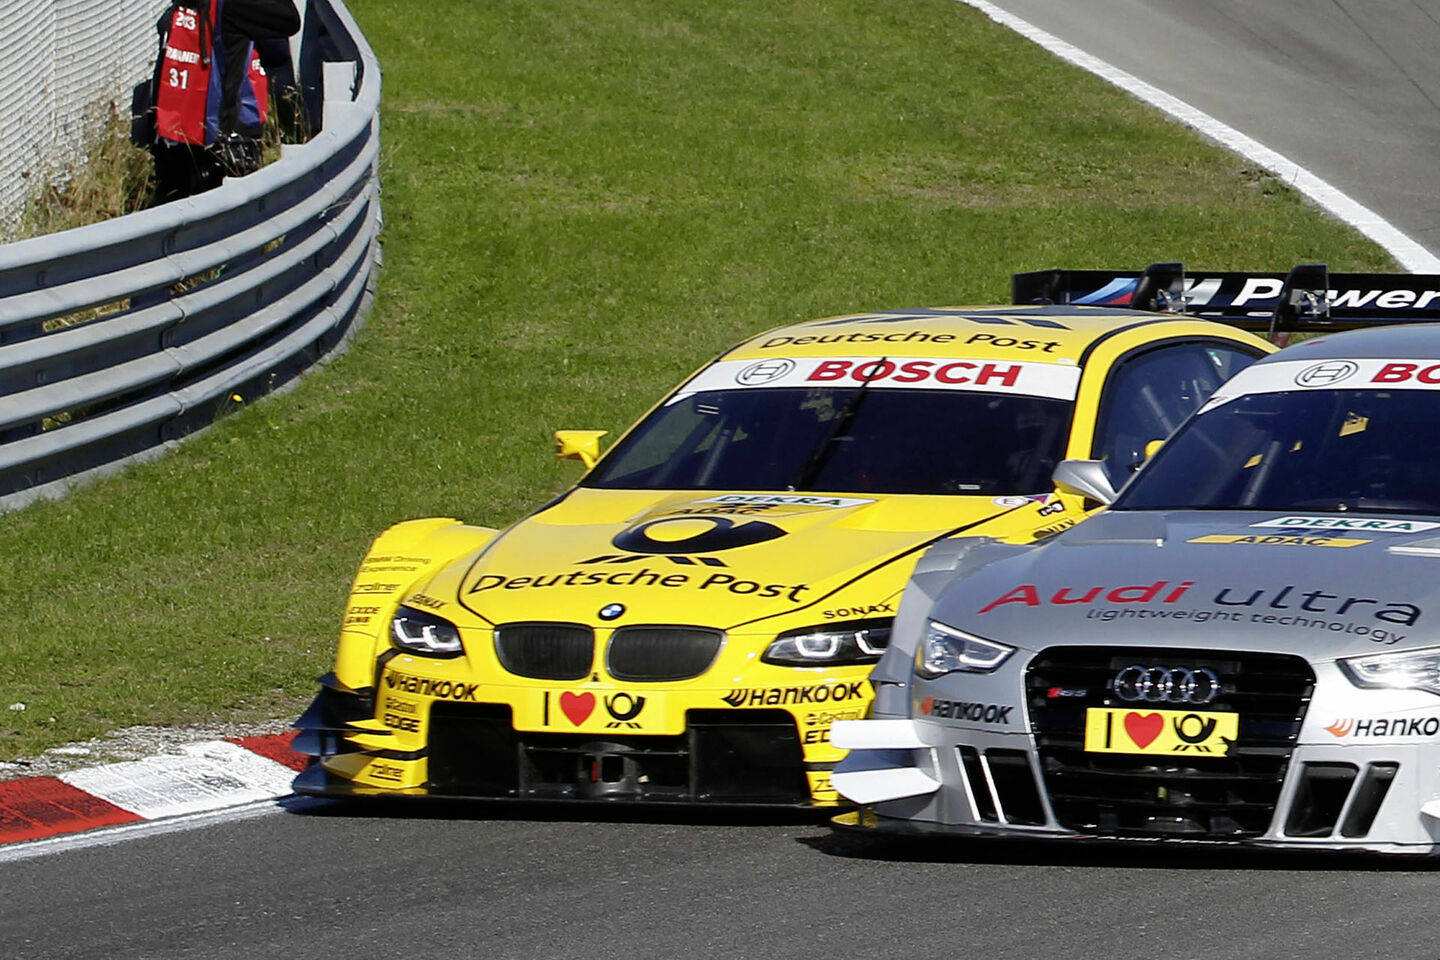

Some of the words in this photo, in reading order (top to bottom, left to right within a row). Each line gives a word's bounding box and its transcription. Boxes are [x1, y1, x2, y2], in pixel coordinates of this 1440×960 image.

[168, 67, 189, 89] 31
[760, 330, 957, 350] Deutsche
[965, 333, 1062, 354] Post
[805, 360, 1024, 388] BOSCH
[715, 495, 842, 506] DEKRA
[1279, 518, 1414, 531] DEKRA
[1231, 536, 1334, 546] ADAC
[466, 568, 689, 596] Deutsche
[697, 572, 813, 603] Post
[822, 603, 895, 620] SONAX
[977, 581, 1197, 614] Audi
[1212, 584, 1422, 627] ultra
[1086, 608, 1244, 627] lightweight
[1249, 613, 1407, 646] technology
